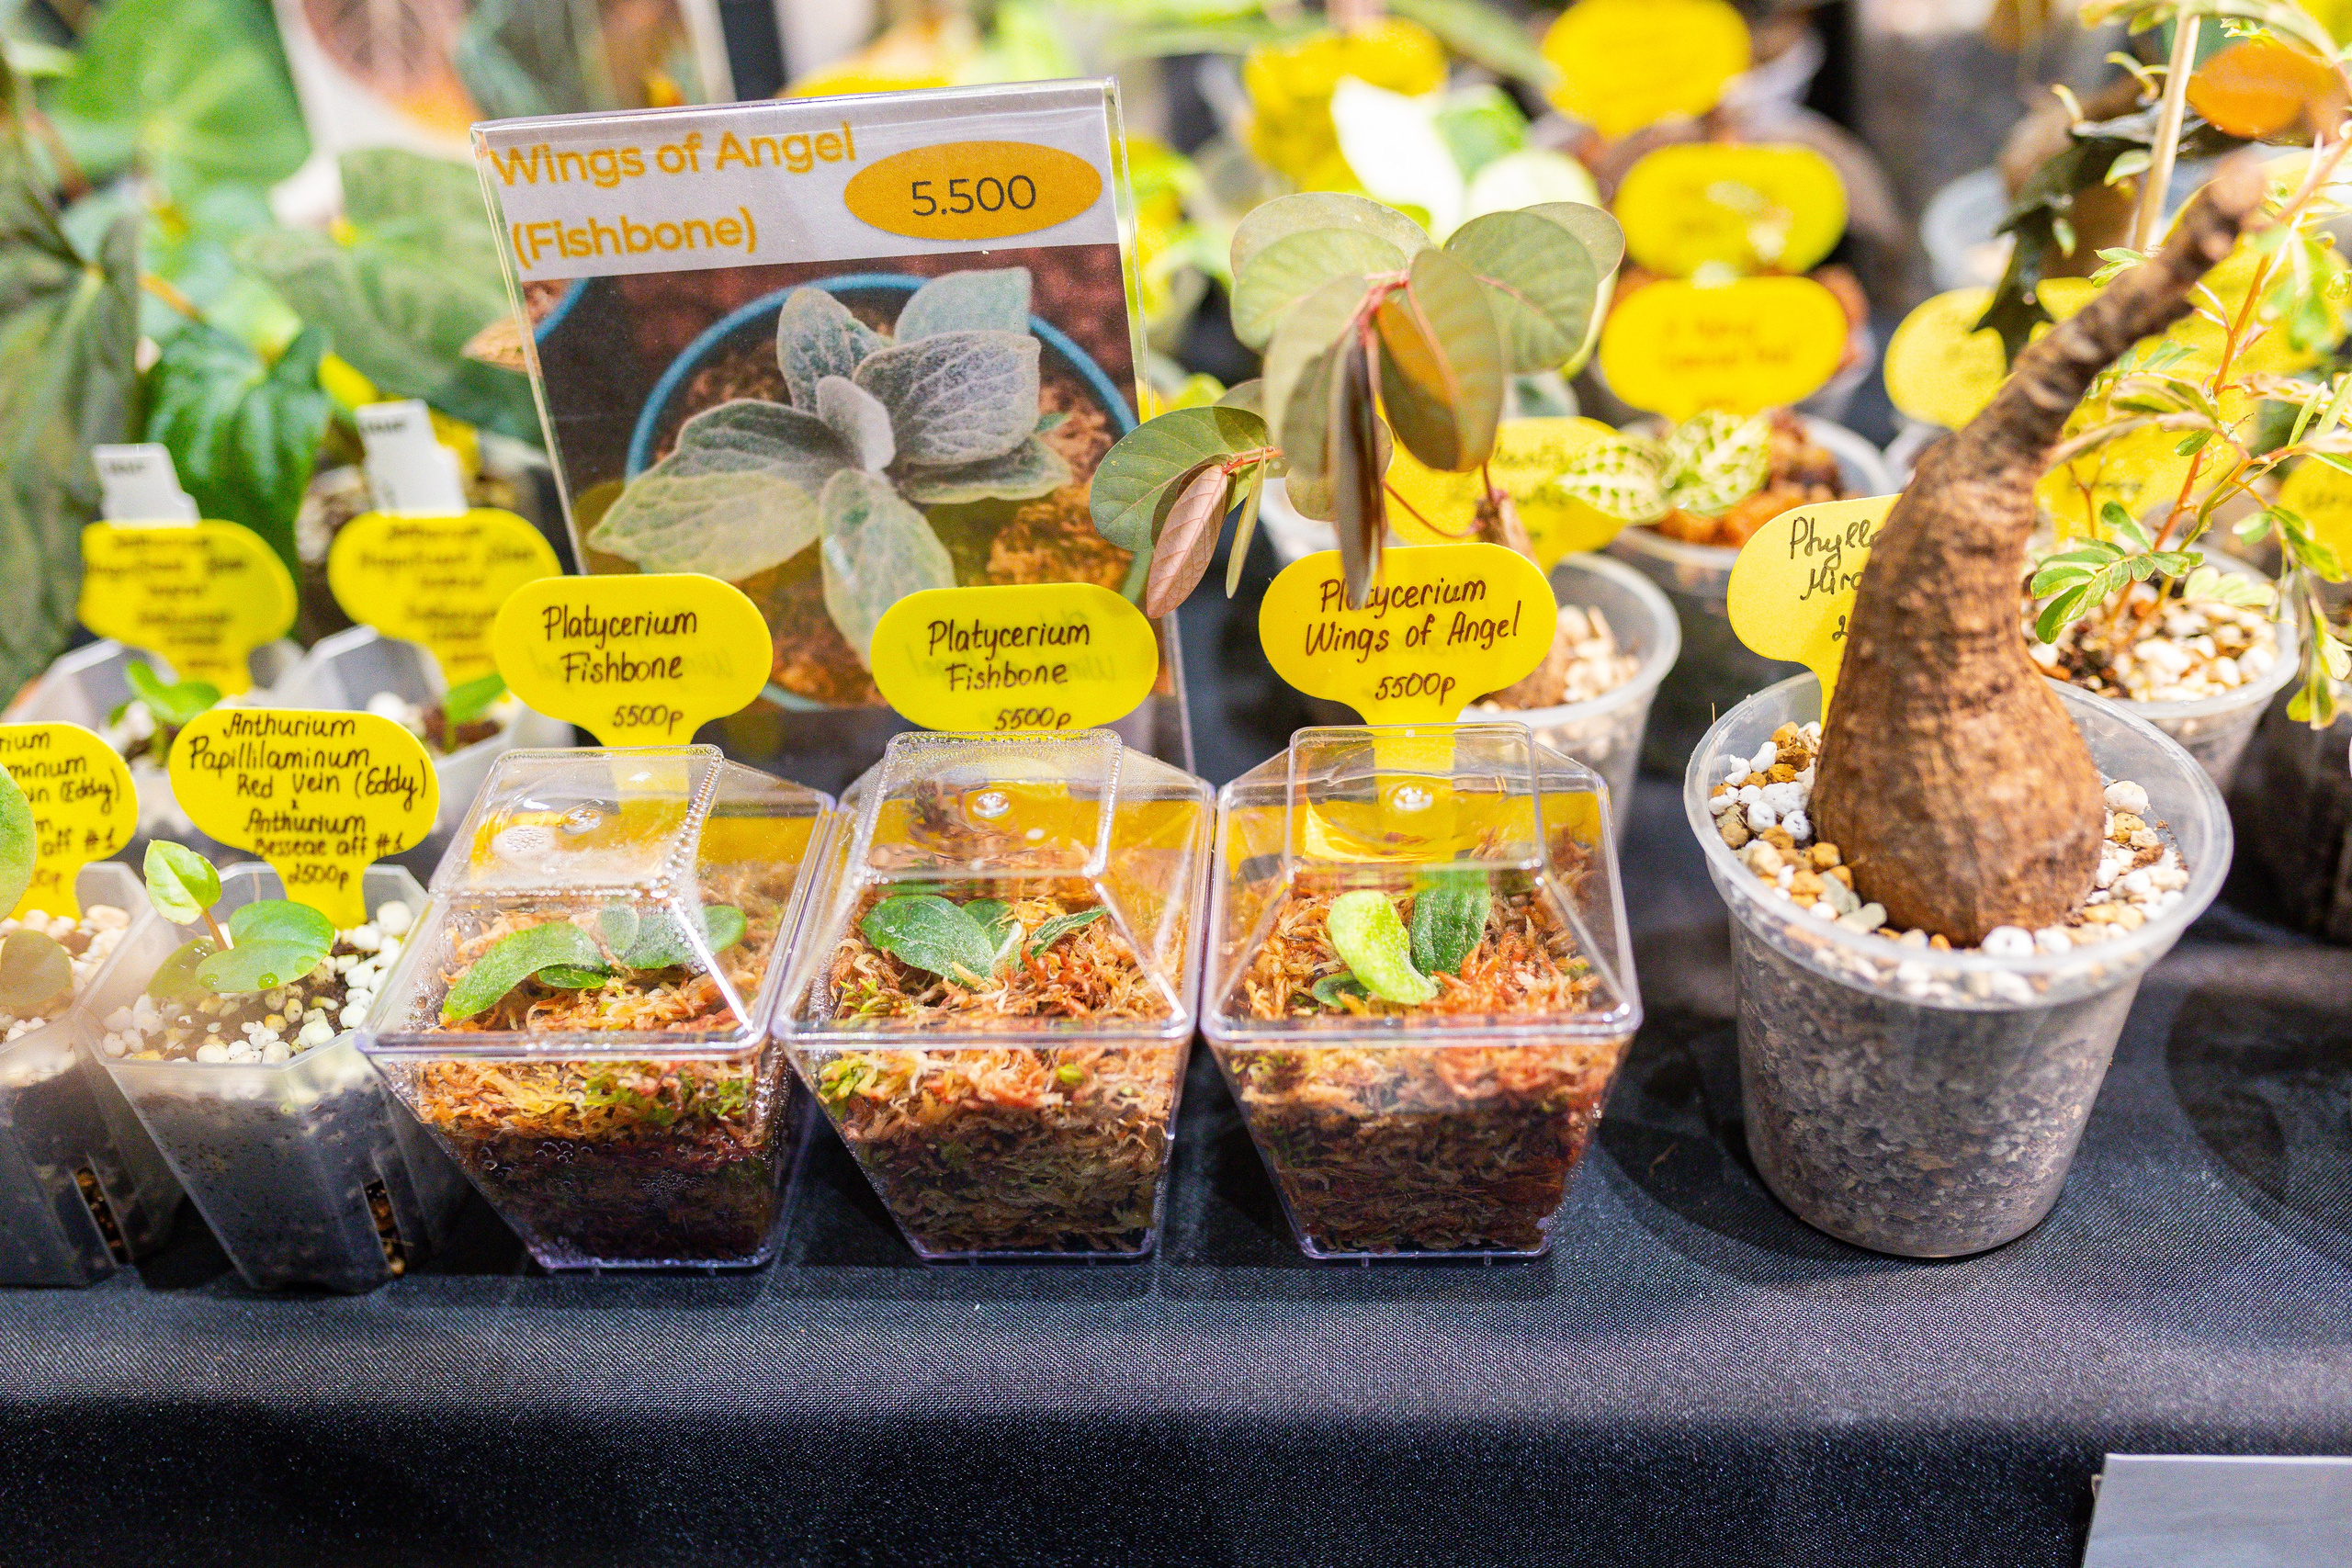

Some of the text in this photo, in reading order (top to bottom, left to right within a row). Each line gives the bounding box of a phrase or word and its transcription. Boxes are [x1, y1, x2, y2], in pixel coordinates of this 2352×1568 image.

[489, 121, 856, 188] Wings of Angel
[912, 175, 1036, 218] 5.500
[511, 207, 758, 269] (Fishbone)
[1319, 578, 1487, 619] Plycerium
[542, 604, 697, 650] Platycerium
[927, 619, 1091, 661] Platycerium
[1305, 600, 1521, 663] Wings of Angel
[560, 650, 683, 683] Fishbone
[944, 660, 1069, 692] Fishbone
[1374, 672, 1455, 705] 5500p
[222, 712, 356, 739] Anthurium
[612, 704, 684, 736] 5500p
[995, 706, 1071, 731] 5500p
[188, 734, 370, 779] Papillilaminum
[235, 773, 274, 799] Red
[243, 807, 366, 834] Anthurium
